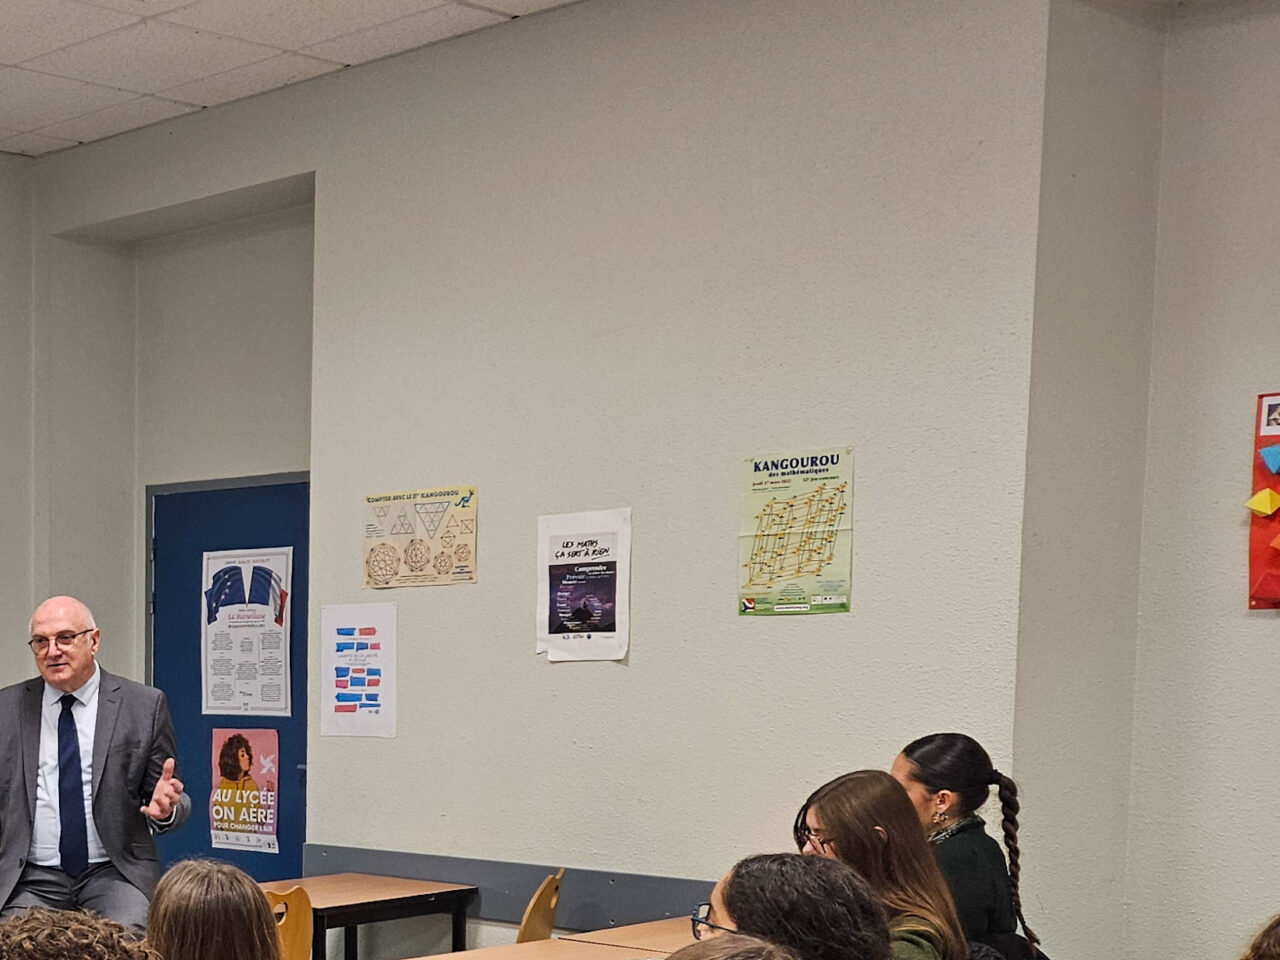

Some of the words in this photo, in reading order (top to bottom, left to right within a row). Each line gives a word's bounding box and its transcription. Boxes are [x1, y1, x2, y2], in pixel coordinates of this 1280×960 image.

[754, 454, 839, 473] KANGOUROU
[781, 467, 829, 476] mathématiques
[562, 541, 574, 549] LES
[574, 565, 607, 573] Comprendre
[213, 788, 232, 802] AU
[235, 787, 275, 805] LYCÉE
[212, 805, 235, 820] ON
[239, 803, 275, 823] AÈRE
[230, 822, 258, 831] CHANGER
